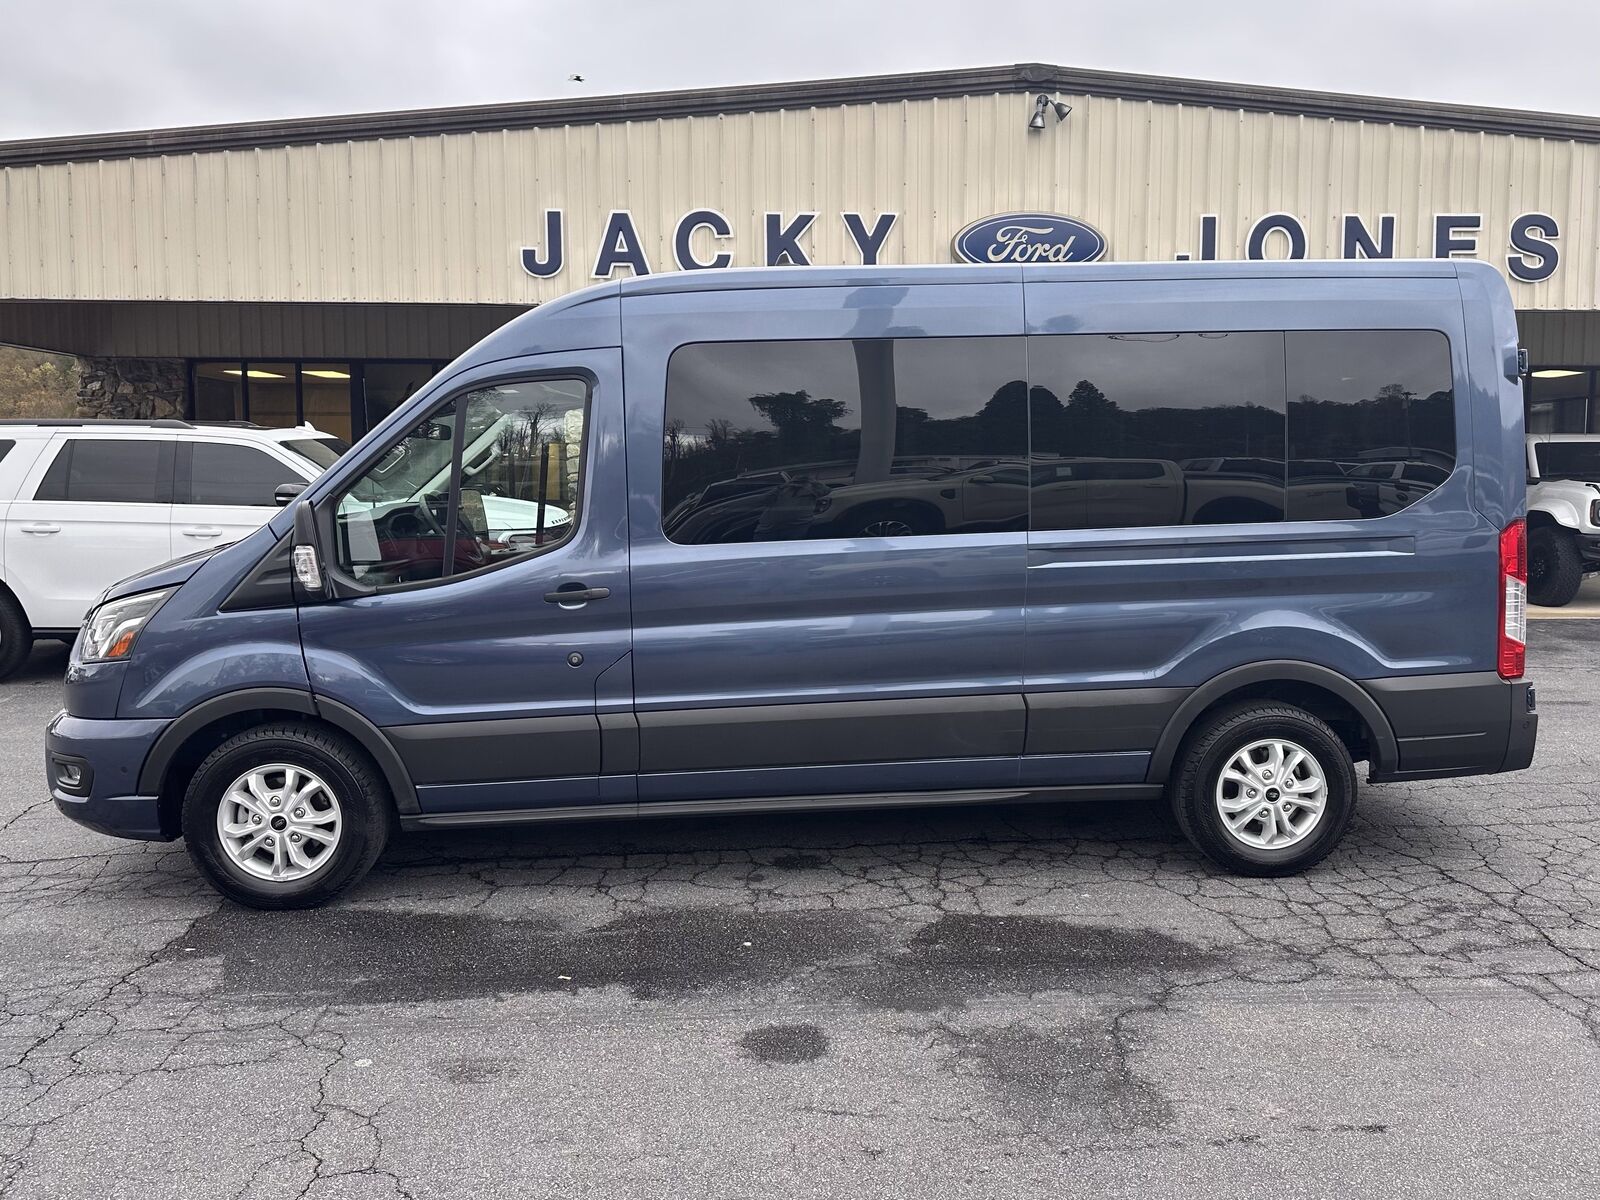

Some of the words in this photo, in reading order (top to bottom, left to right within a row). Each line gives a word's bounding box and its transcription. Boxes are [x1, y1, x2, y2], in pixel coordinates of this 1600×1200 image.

[520, 208, 899, 278] JACKY
[1175, 212, 1560, 283] JONES
[987, 225, 1076, 262] Ford
